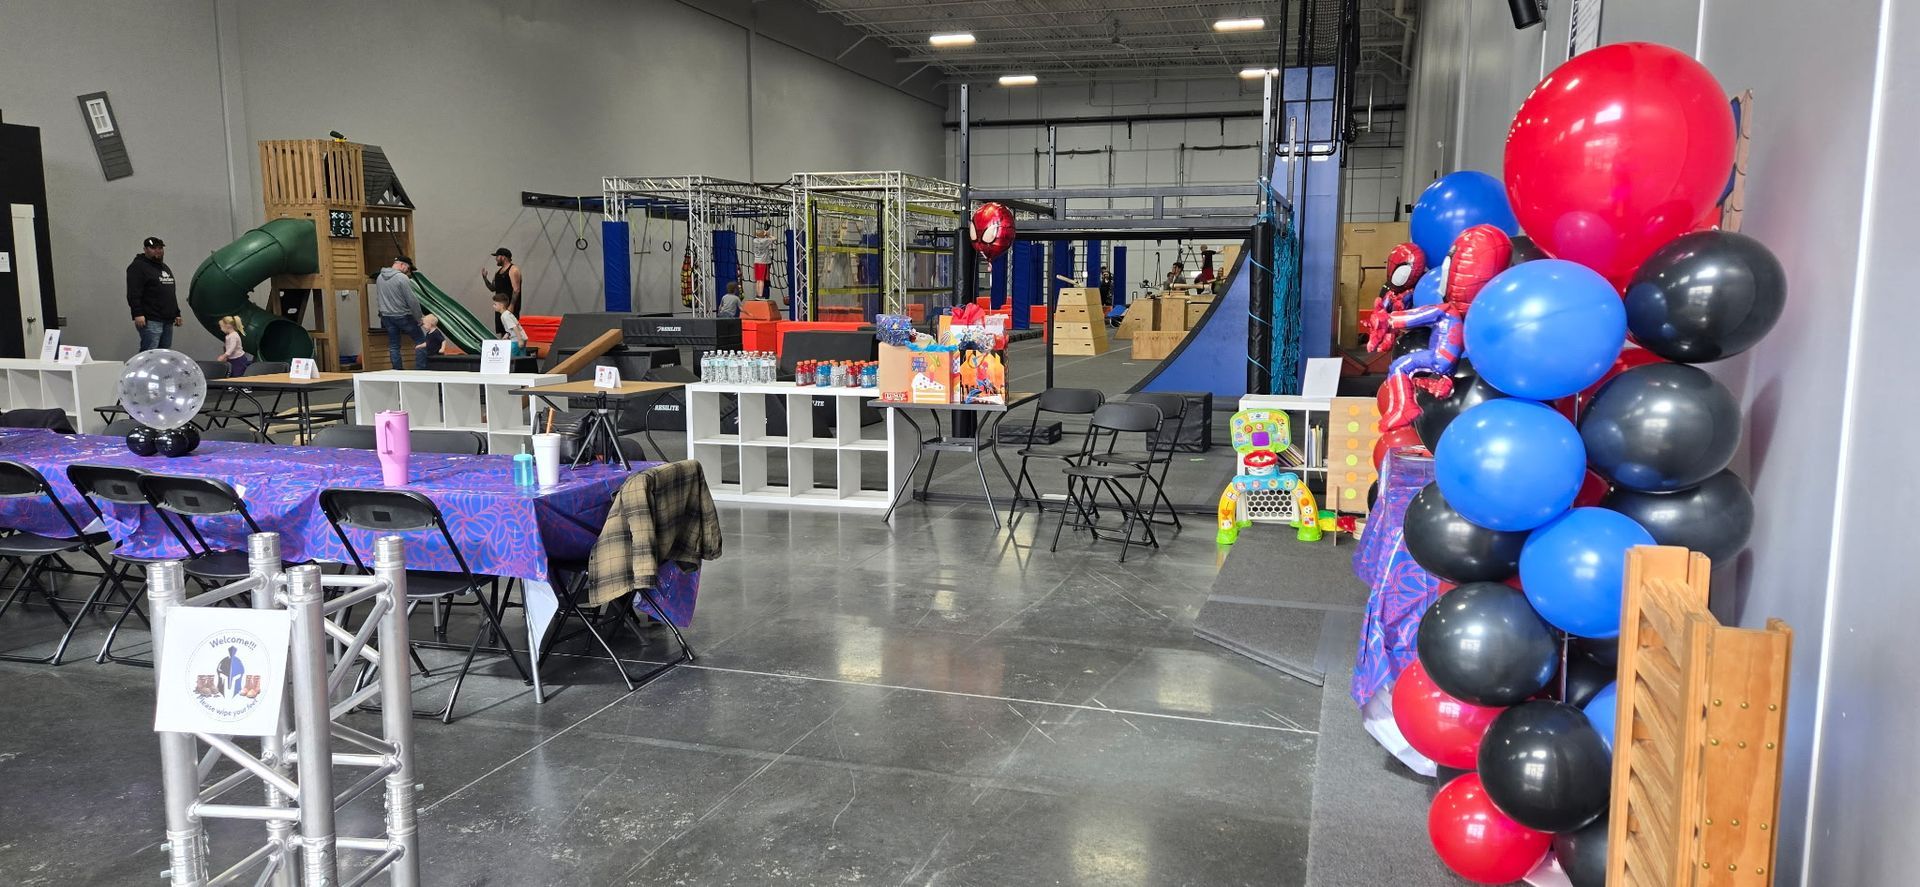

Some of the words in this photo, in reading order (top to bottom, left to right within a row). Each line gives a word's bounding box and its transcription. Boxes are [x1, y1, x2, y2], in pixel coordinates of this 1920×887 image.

[209, 636, 257, 651] Welcome!!!
[197, 694, 216, 712] Please
[216, 707, 232, 717] wipe
[233, 707, 246, 717] your
